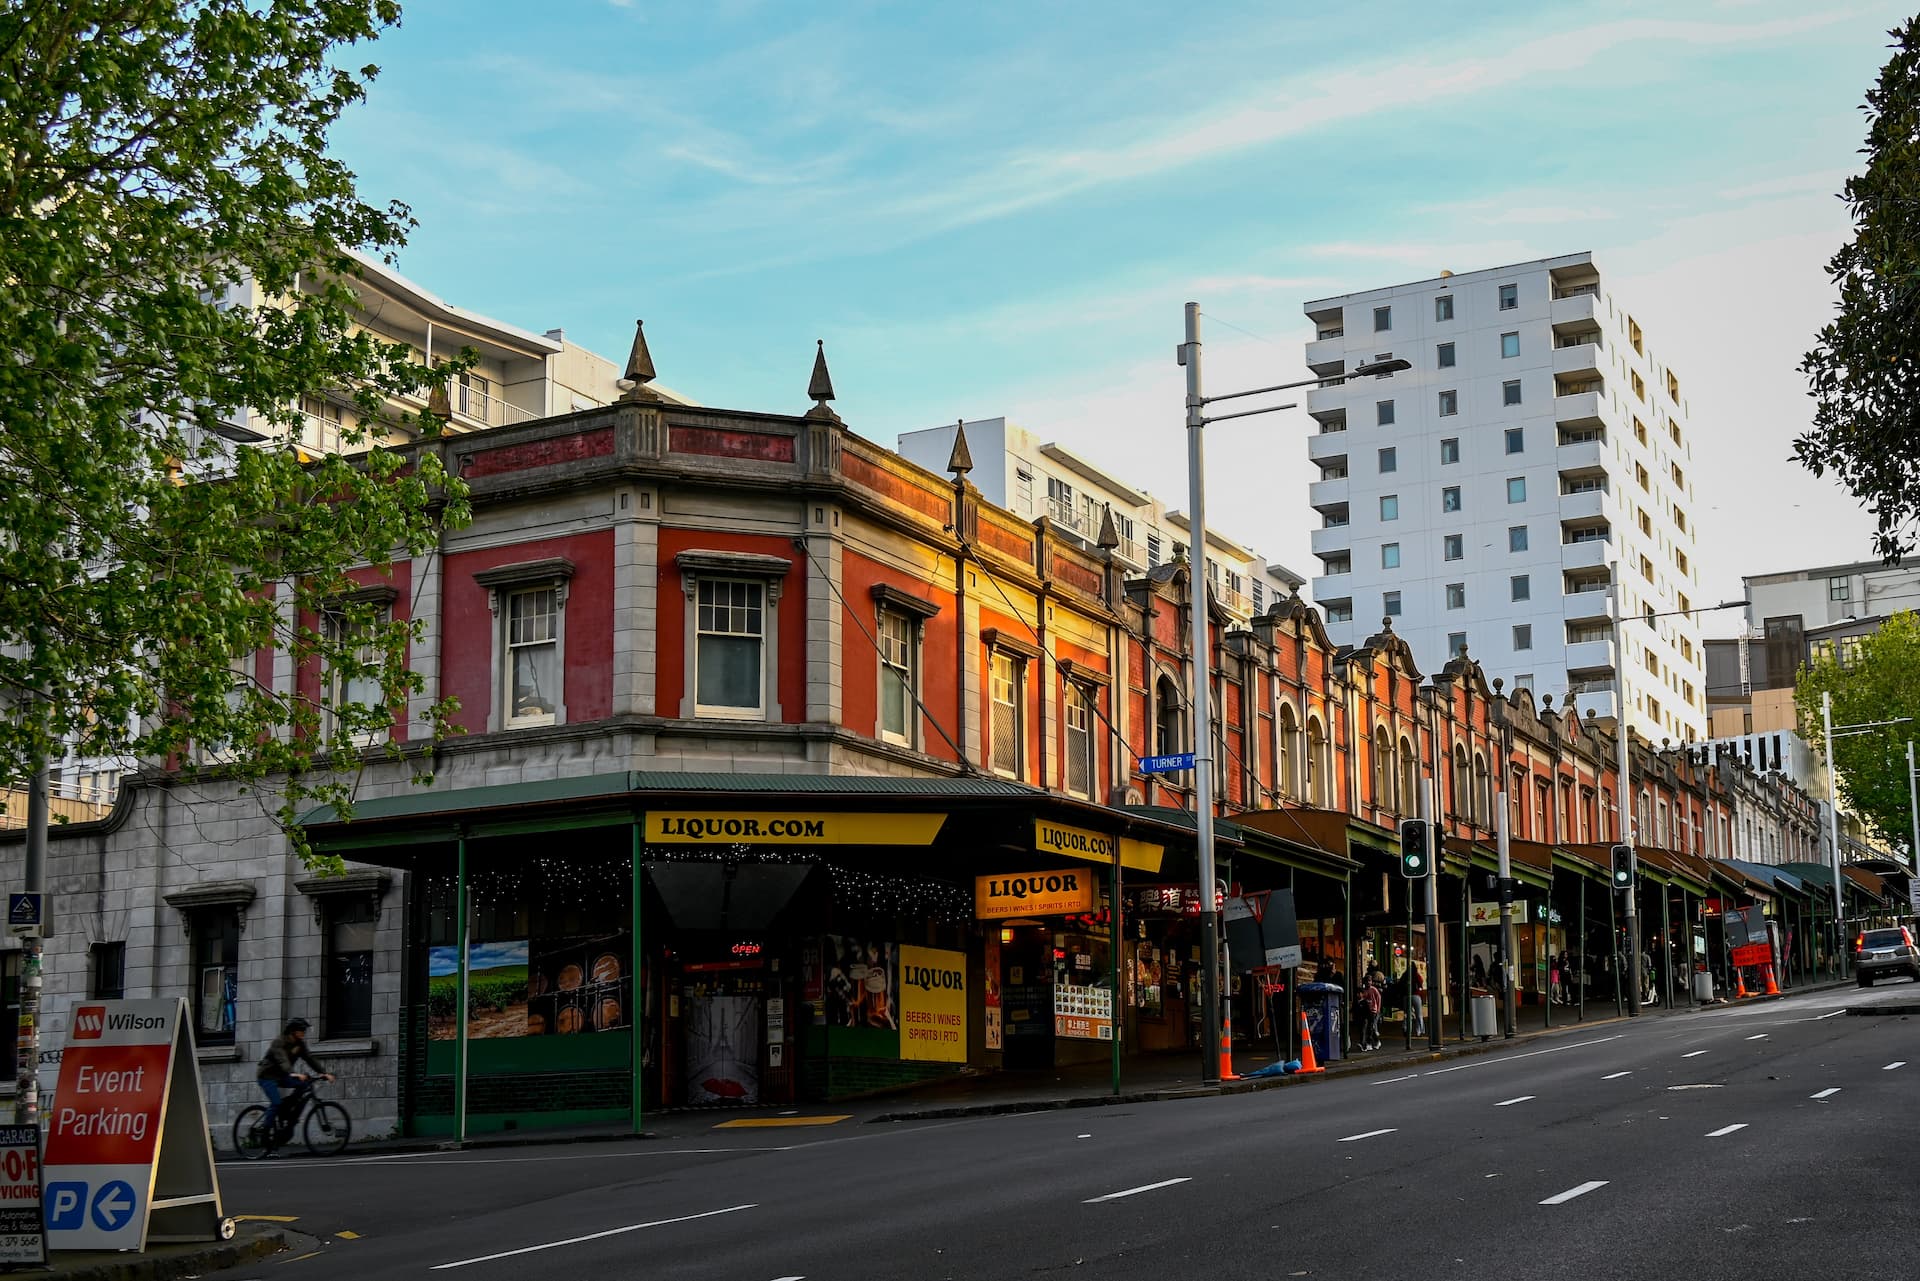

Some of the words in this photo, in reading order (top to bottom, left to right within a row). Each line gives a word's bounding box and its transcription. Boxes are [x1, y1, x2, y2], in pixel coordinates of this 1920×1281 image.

[1151, 756, 1183, 769] TURNER
[660, 817, 825, 838] LIQUOR.COM
[989, 874, 1079, 899] LIQUOR
[986, 905, 1009, 914] BEERS
[1013, 904, 1034, 912] WINES
[1038, 902, 1063, 910] SPIRITS
[731, 945, 761, 954] OPEN
[904, 965, 963, 991] LIQUOR
[108, 1013, 165, 1031] Wilson
[906, 1010, 932, 1024] BEERS
[937, 1013, 961, 1026] WINES
[908, 1027, 938, 1041] SPIRITS
[943, 1030, 959, 1042] RTD
[76, 1065, 145, 1094] Event
[57, 1107, 149, 1141] Parking
[0, 1128, 37, 1145] GARAGE
[0, 1184, 40, 1200] VICING
[52, 1190, 78, 1222] P
